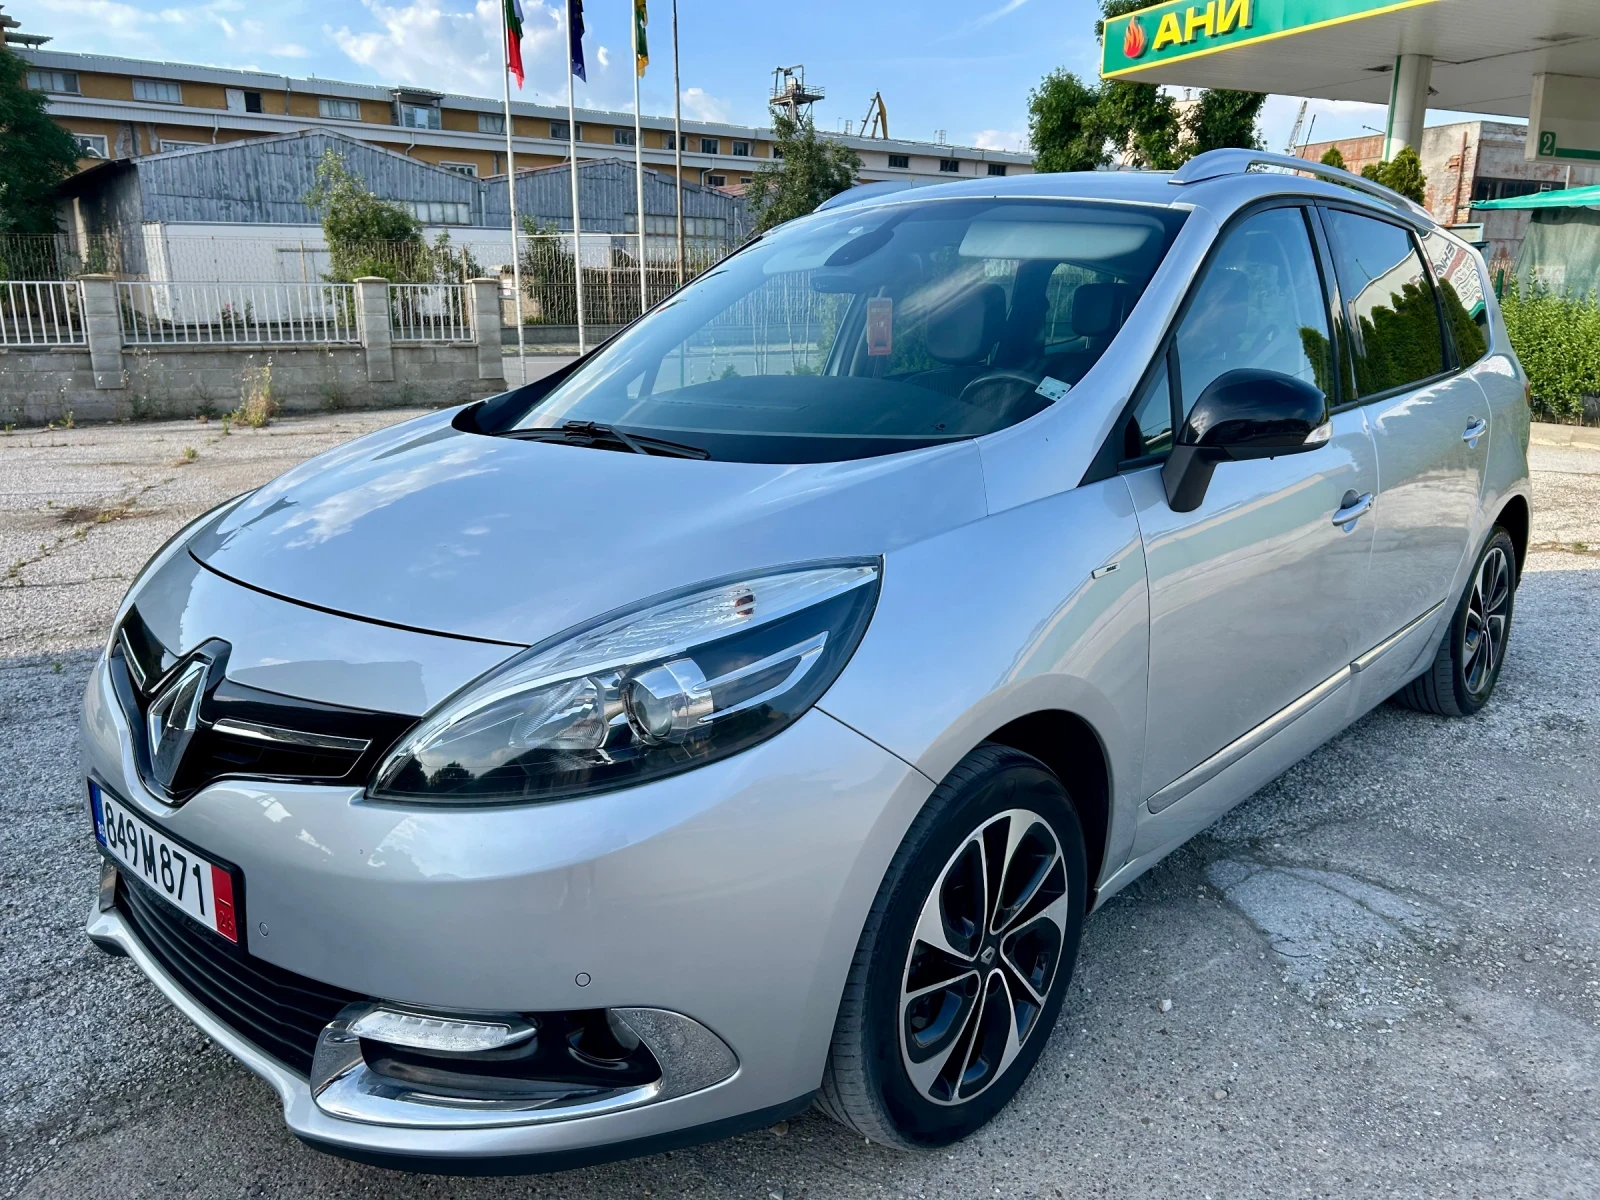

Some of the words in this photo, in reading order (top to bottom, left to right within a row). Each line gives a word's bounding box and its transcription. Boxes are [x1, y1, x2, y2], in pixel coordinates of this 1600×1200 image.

[1152, 0, 1253, 50] АНИ
[1542, 133, 1553, 154] 2
[105, 801, 206, 917] 849M871
